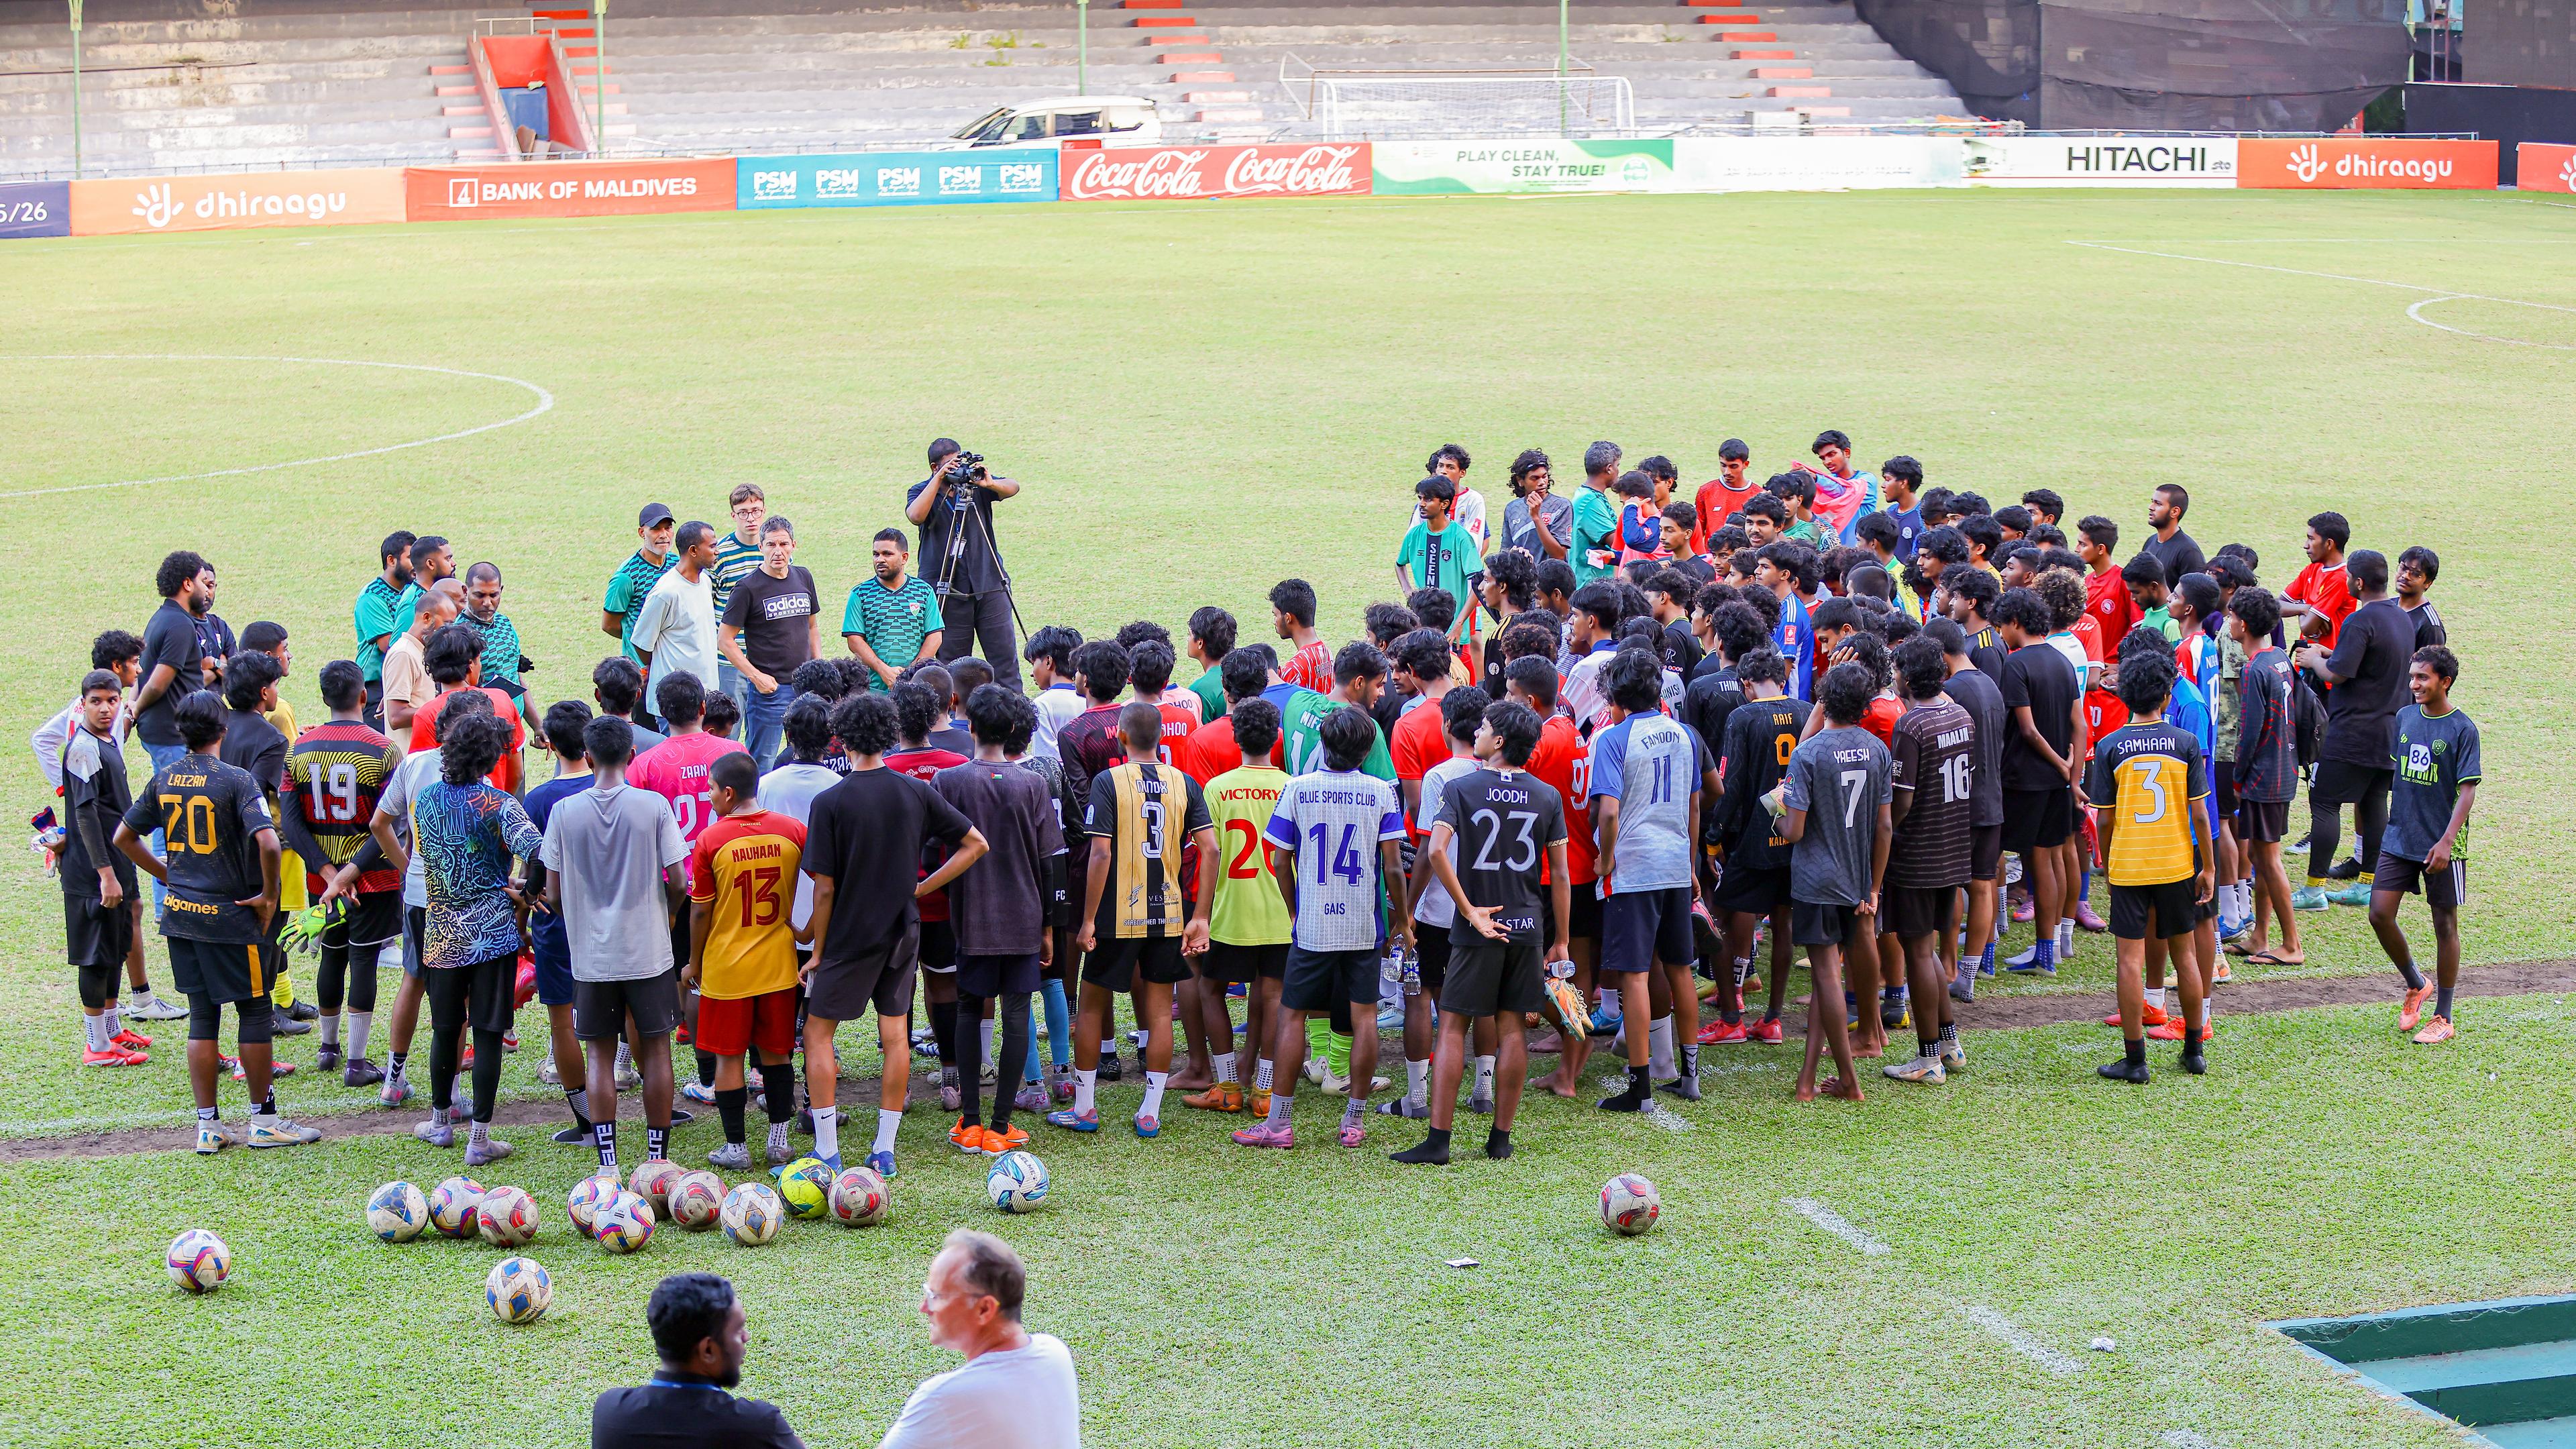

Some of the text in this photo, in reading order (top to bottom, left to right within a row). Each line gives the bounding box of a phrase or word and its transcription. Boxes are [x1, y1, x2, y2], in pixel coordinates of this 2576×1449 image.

[1457, 150, 1560, 162] PLAY CLEAN,
[2068, 147, 2206, 172] HITACHI
[815, 168, 859, 189] PSM
[877, 167, 920, 188] PSM
[938, 166, 982, 186] PSM
[1000, 164, 1042, 184] PSM
[1073, 150, 1210, 199] Coca-Cola
[1225, 146, 1360, 193] Coca-Cola
[1512, 165, 1606, 177] STAY TRUE!
[2335, 154, 2453, 182] dhiraagu
[482, 178, 697, 201] BANK OF MALDIVES
[753, 170, 797, 191] PSM
[195, 192, 347, 220] dhiraagu
[1427, 543, 1437, 590] SEEN
[767, 596, 810, 612] adidas
[1718, 680, 1741, 692] THIM
[1299, 710, 1324, 731] MIFZ
[1556, 705, 1570, 716] SAL
[1641, 731, 1680, 751] FANOON
[2116, 737, 2176, 755] SAMHAAN
[2412, 749, 2428, 766] 86
[680, 763, 708, 780] ZAAN
[1650, 754, 1671, 805] 11
[1938, 753, 1970, 804] 16
[308, 762, 358, 820] 19
[1220, 788, 1281, 802] VICTORY
[1299, 790, 1376, 807] BLUE SPORTS CLUB
[1486, 788, 1529, 805] JOODH
[1841, 769, 1867, 828] 7
[2132, 761, 2166, 823] 3
[159, 794, 217, 855] 20
[1140, 800, 1165, 859] 3
[1470, 808, 1540, 872] 23
[731, 843, 782, 863] NAUHAAN
[1309, 822, 1364, 887] 14
[733, 865, 782, 928] 13
[1055, 890, 1066, 902] FC
[1324, 902, 1346, 915] GAIS
[1123, 918, 1157, 926] STRENGTHEN
[1157, 917, 1167, 925] THE
[1506, 917, 1536, 930] STAR
